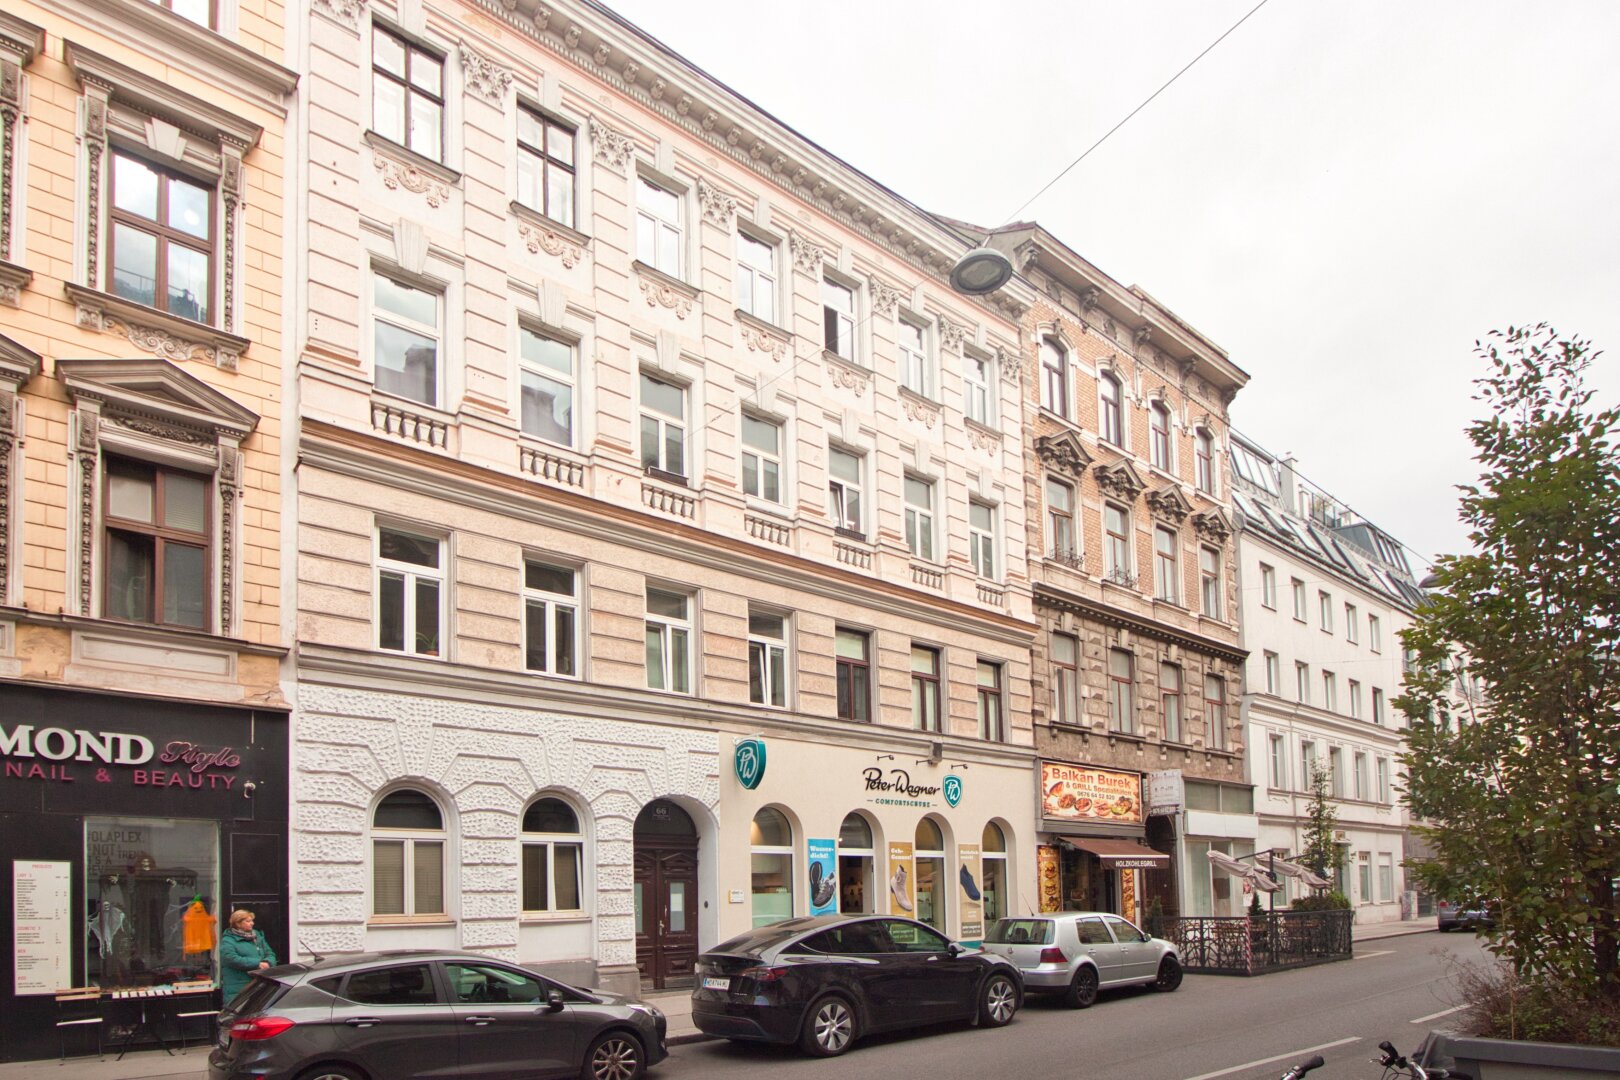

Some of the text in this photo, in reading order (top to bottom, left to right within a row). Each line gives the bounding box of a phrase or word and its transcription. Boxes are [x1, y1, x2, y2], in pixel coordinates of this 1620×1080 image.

[5, 761, 237, 790] NAIL & BEAUTY
[862, 767, 941, 798] Peter Wagner
[1052, 768, 1131, 789] Balkan Burek
[1072, 783, 1092, 792] GRILL
[1115, 860, 1157, 868] HOLZKOHLEGRILL
